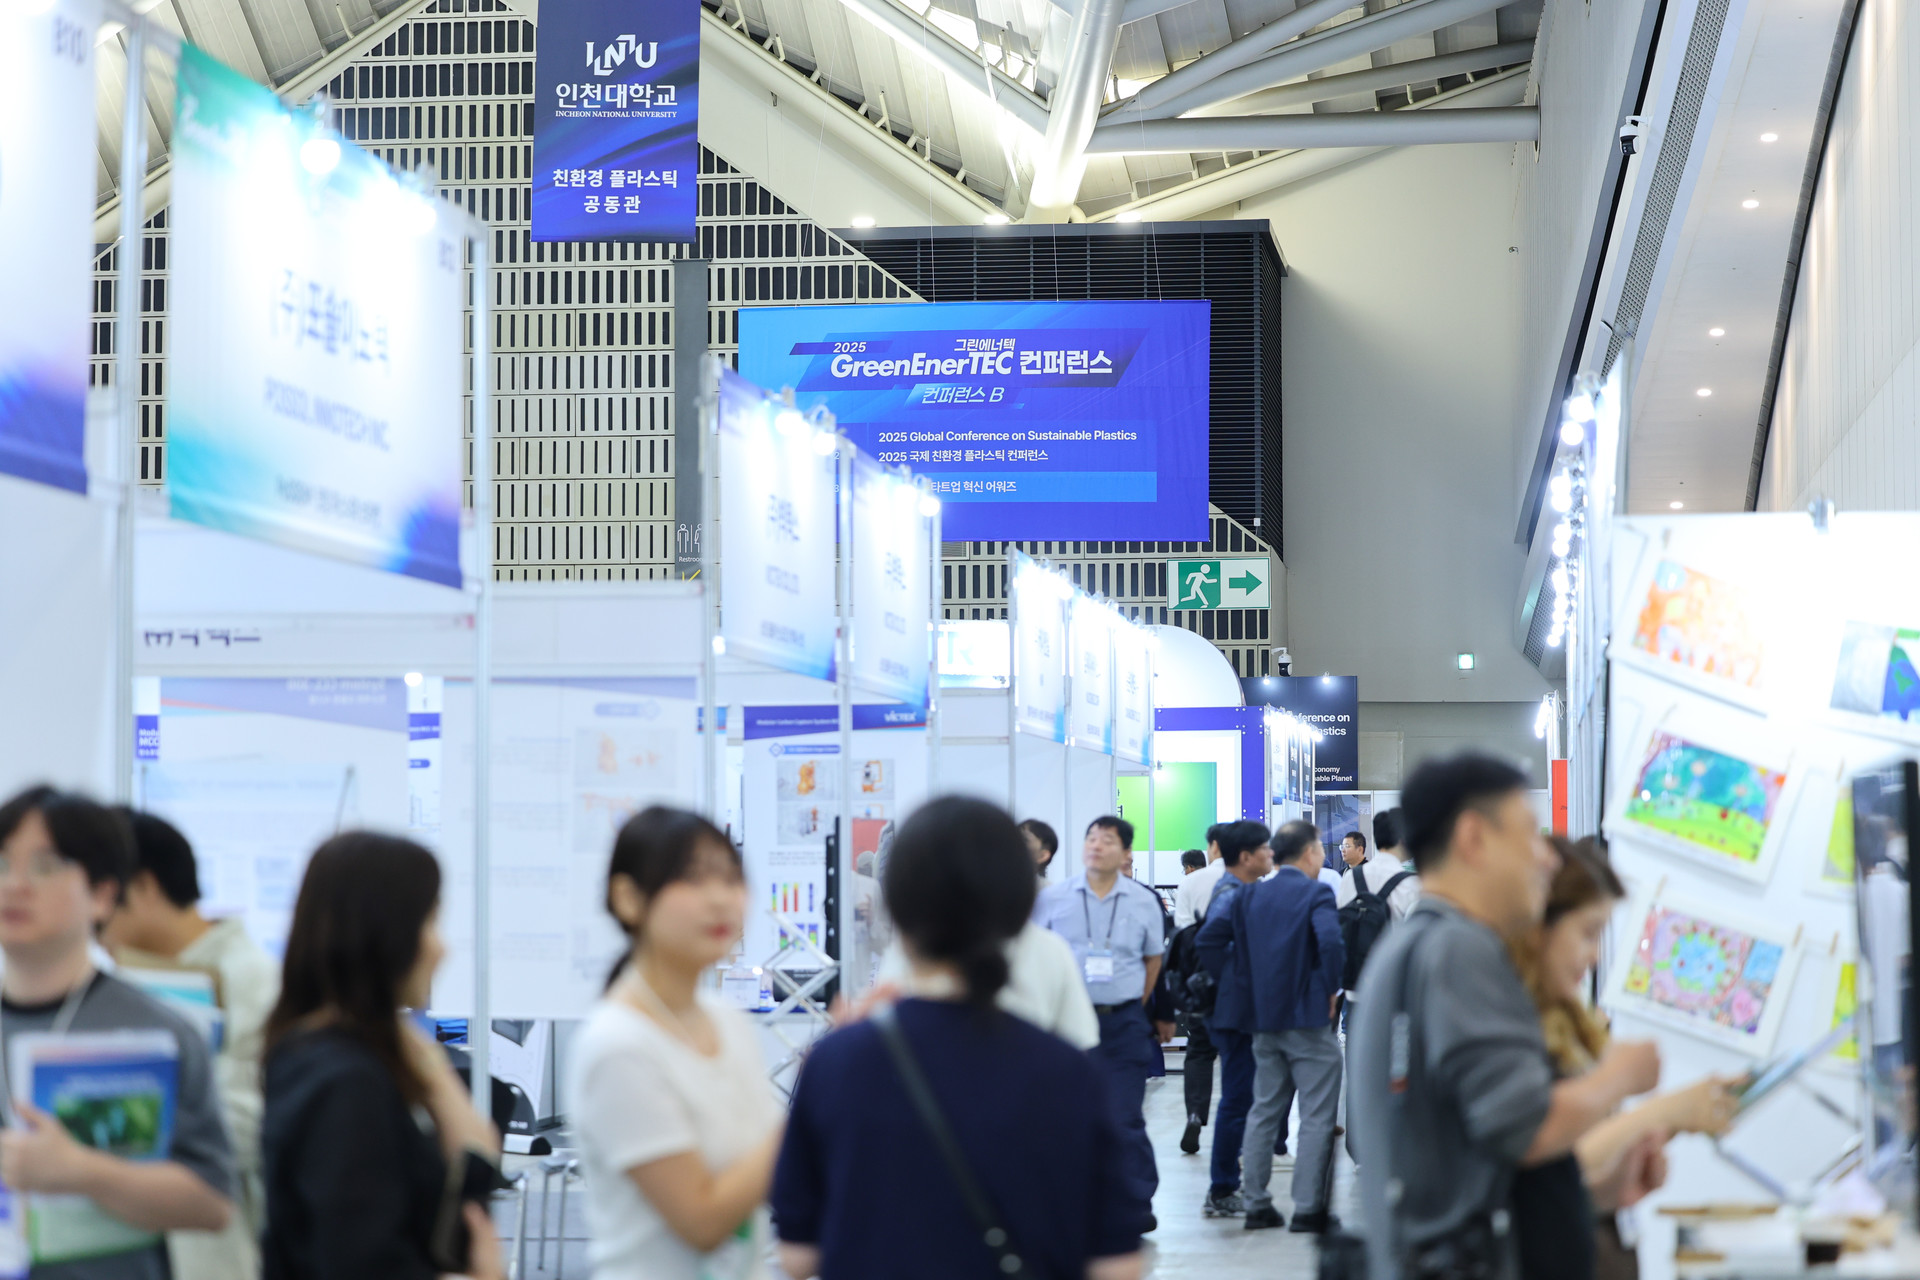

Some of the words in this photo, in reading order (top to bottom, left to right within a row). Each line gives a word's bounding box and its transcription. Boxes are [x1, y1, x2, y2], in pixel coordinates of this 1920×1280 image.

[555, 82, 678, 109] 인천대학교
[555, 110, 591, 118] INCHEON
[552, 169, 603, 188] 친환경
[609, 169, 678, 188] 플라스틱
[832, 341, 867, 353] 2025
[953, 337, 1016, 353] 그린에너텍
[830, 350, 1015, 378] GreenEnerTEC
[1019, 349, 1113, 376] 컨퍼런스
[921, 386, 986, 404] 컨퍼런스
[988, 386, 1005, 403] B
[878, 432, 907, 443] 2025
[909, 431, 944, 442] Global
[945, 430, 1009, 442] Conference
[1011, 431, 1026, 441] on
[1027, 429, 1092, 441] Sustainable
[1093, 429, 1137, 441] Plastics
[878, 451, 907, 462] 2025
[909, 450, 930, 462] 국제
[931, 450, 962, 462] 친환경
[963, 449, 1005, 462] 플라스틱
[1007, 449, 1048, 462] 컨퍼런스
[930, 480, 961, 493] 타트업
[963, 480, 984, 493] 혁신
[985, 480, 1017, 493] 어워즈
[1337, 714, 1350, 722] on
